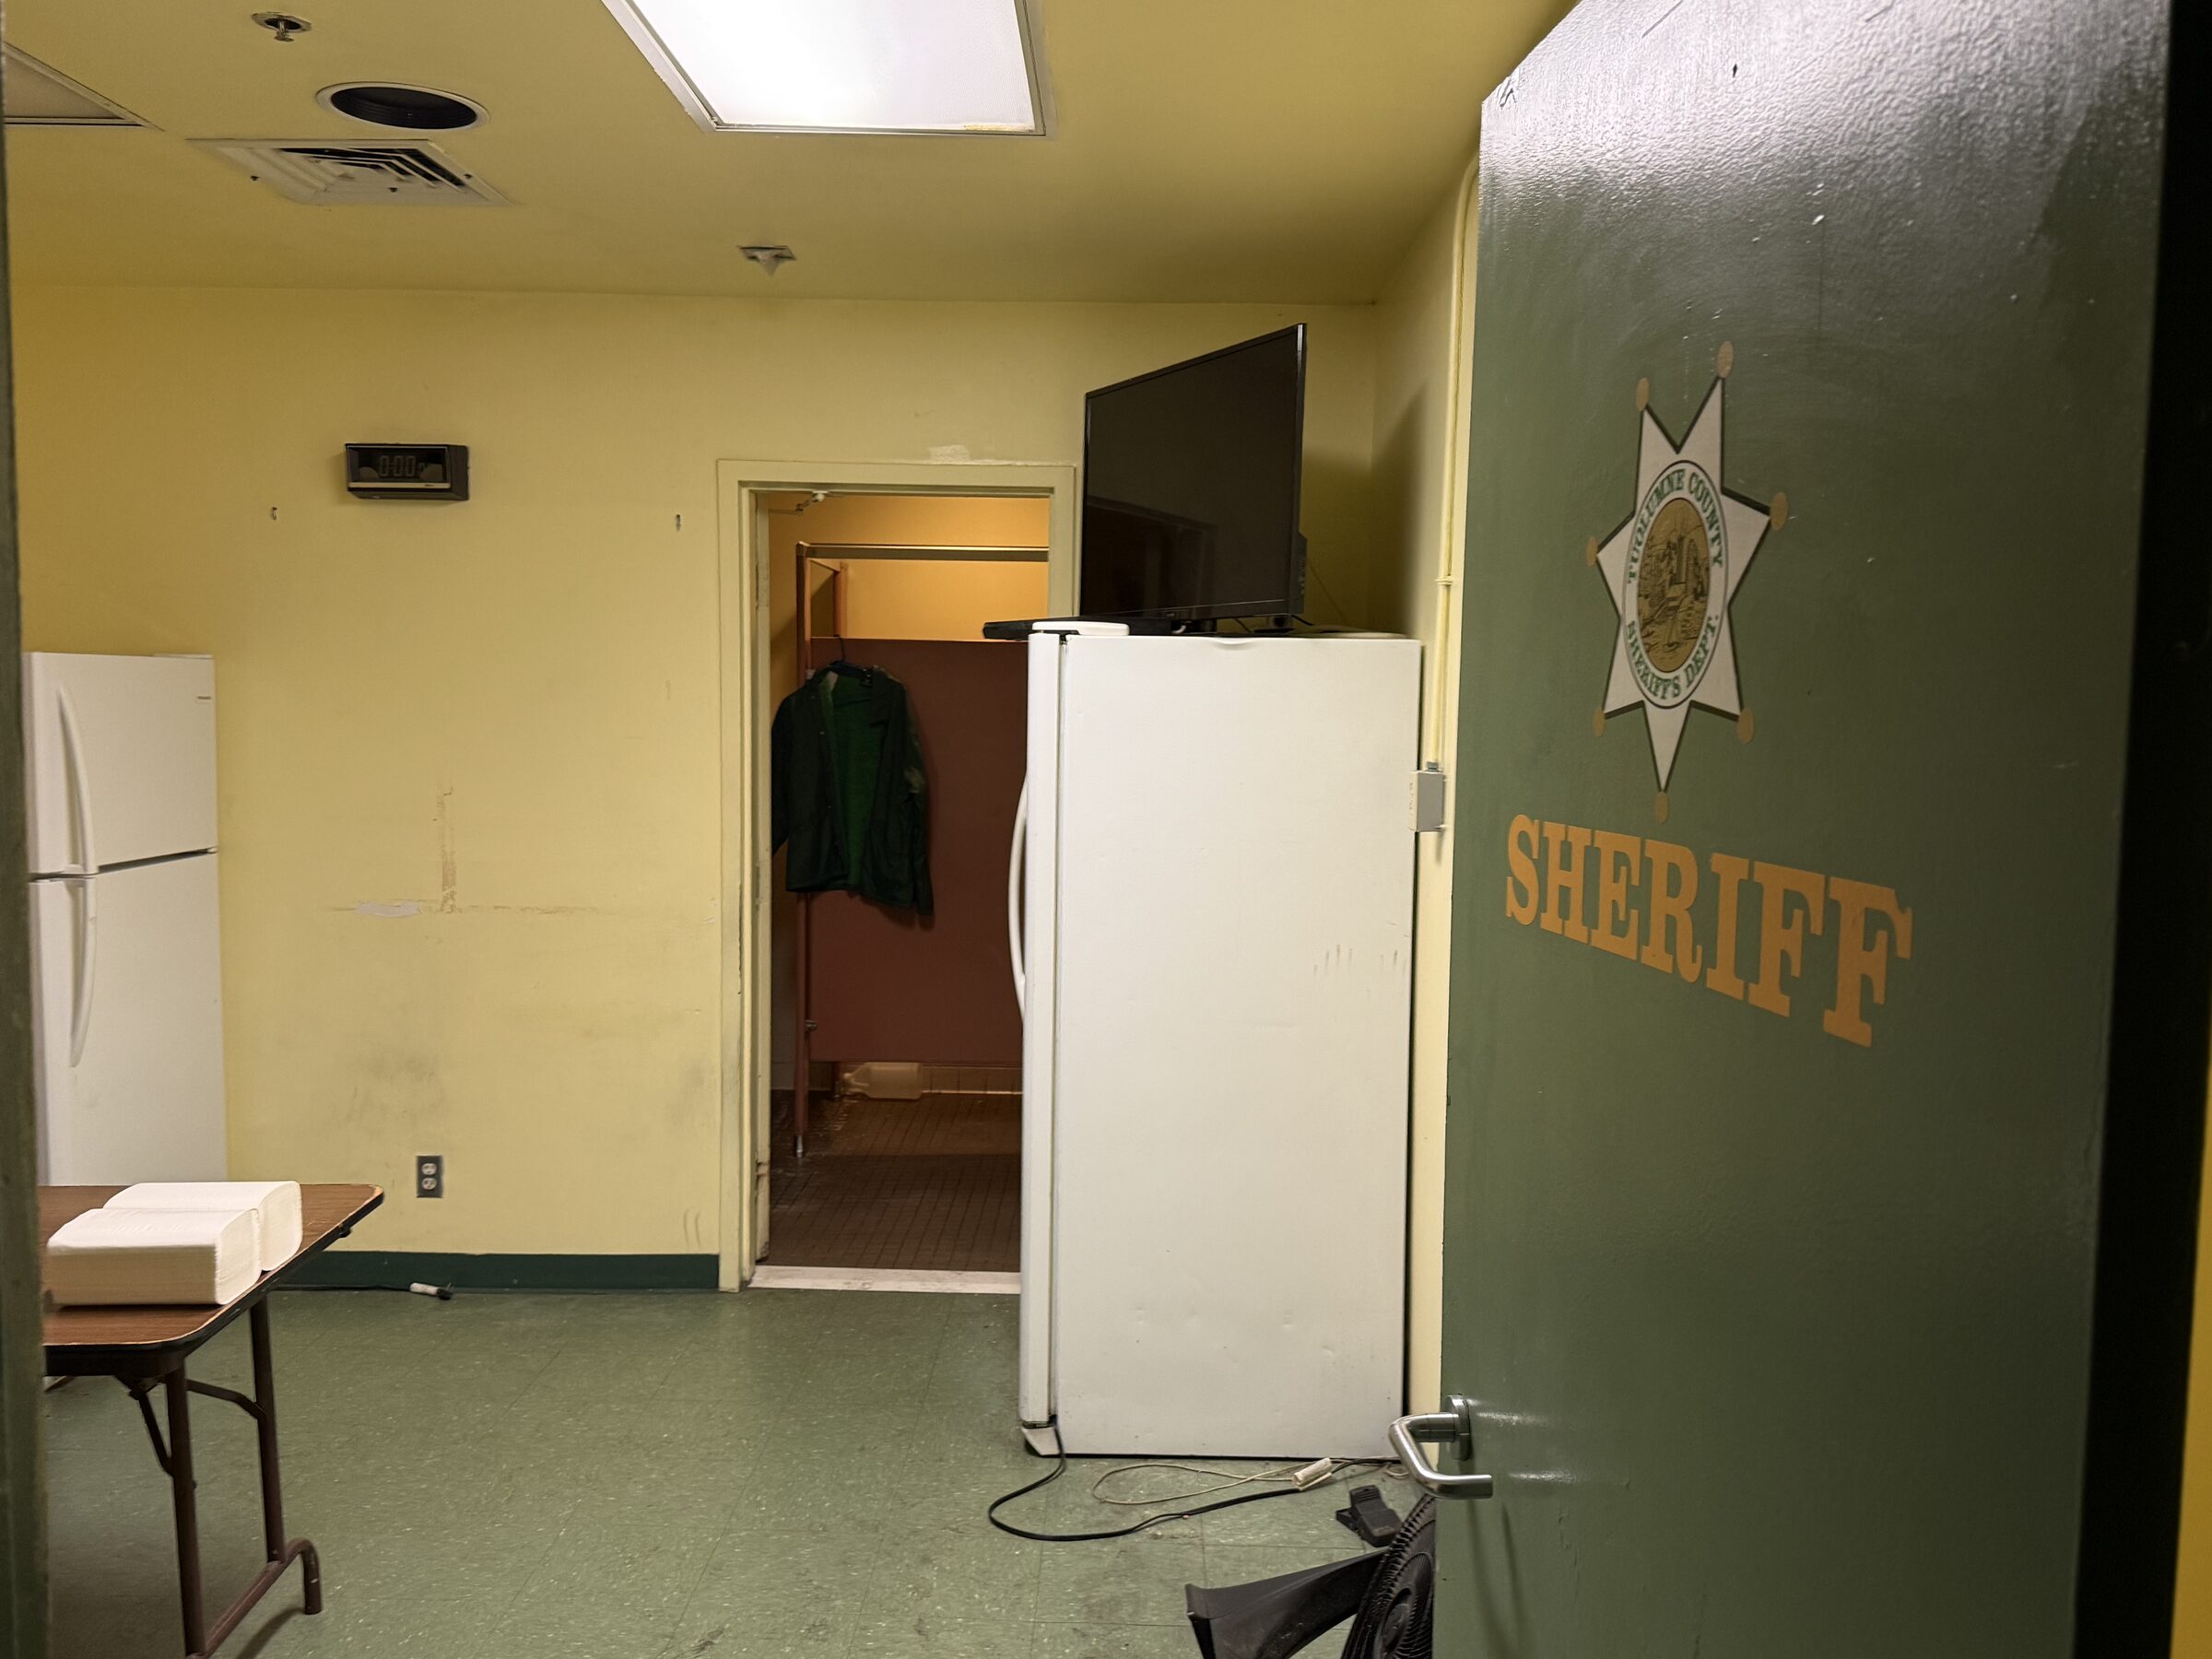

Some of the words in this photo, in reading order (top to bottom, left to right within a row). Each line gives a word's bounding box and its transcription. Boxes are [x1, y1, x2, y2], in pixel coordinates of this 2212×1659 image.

[1628, 468, 1686, 584] TUOLUMNE
[1688, 472, 1724, 568] COUNTY
[1626, 619, 1681, 700] SHERIFF'S
[1505, 814, 1912, 1048] SHERIFF
